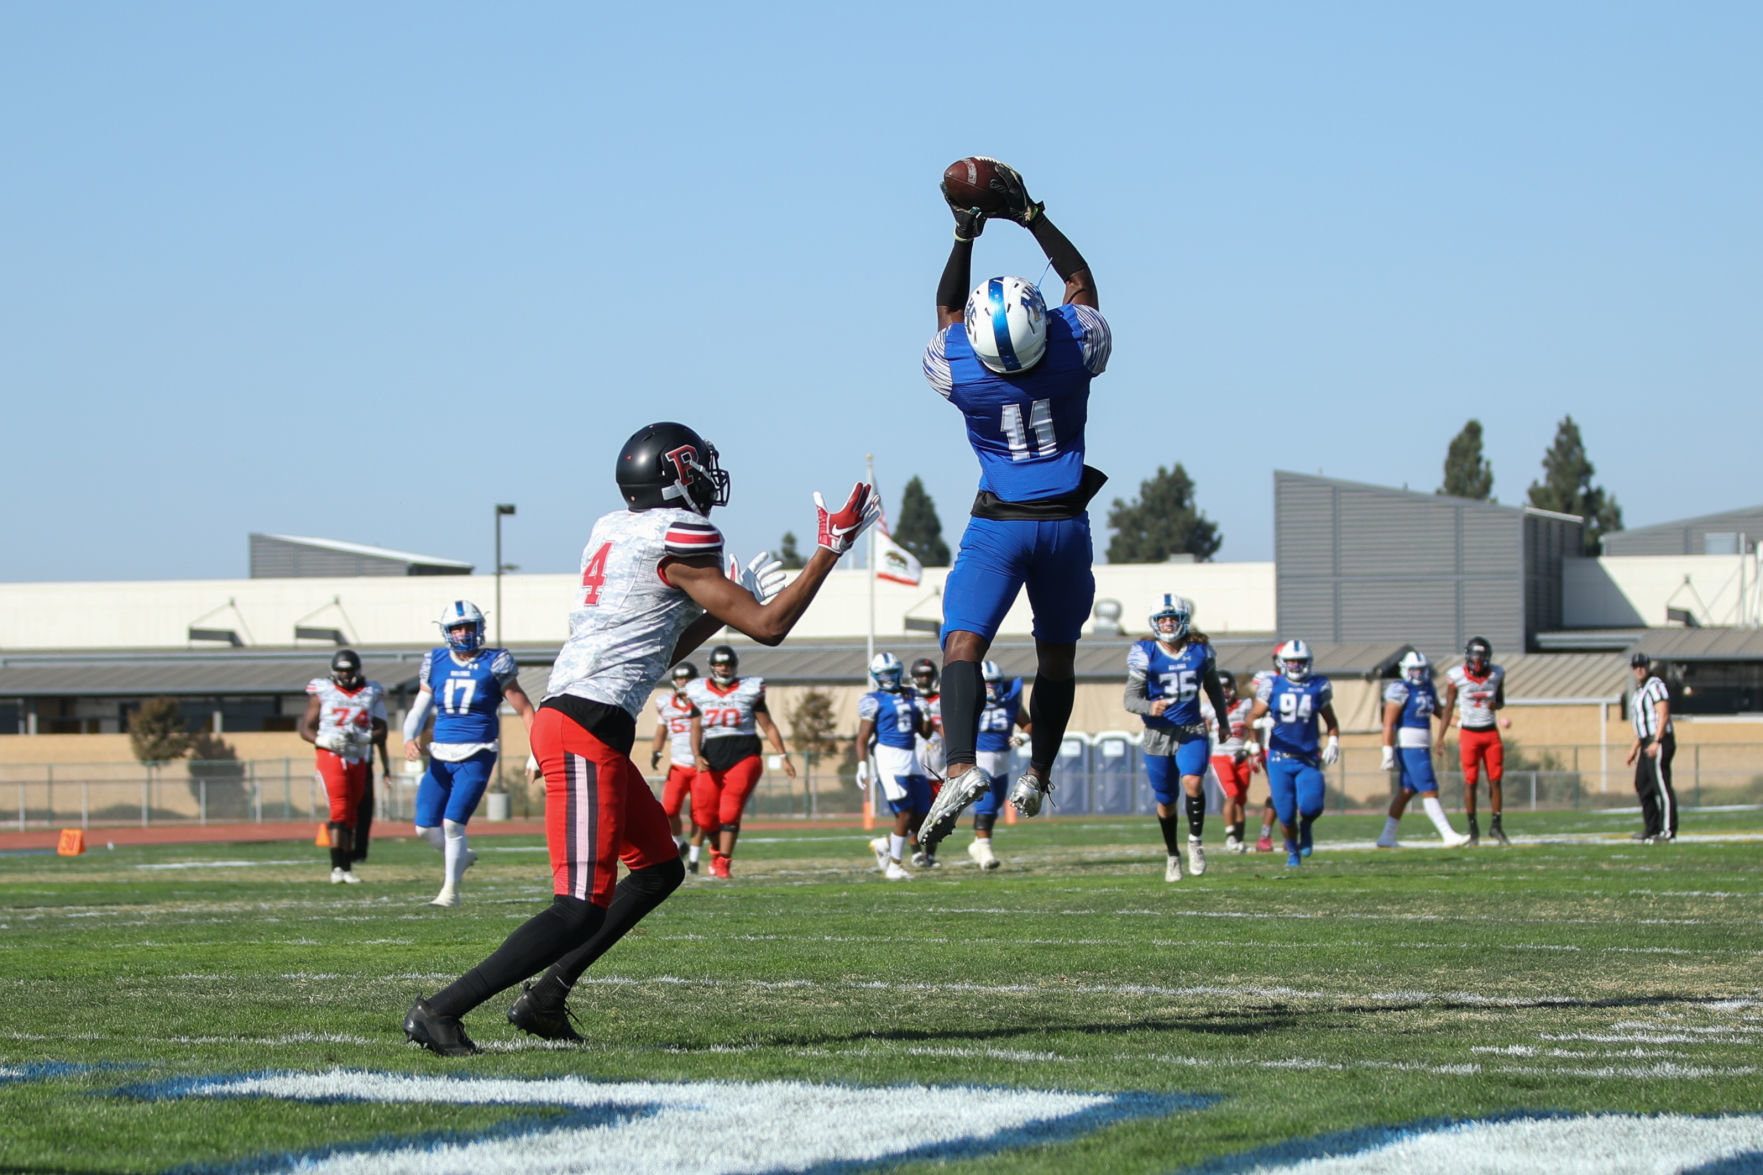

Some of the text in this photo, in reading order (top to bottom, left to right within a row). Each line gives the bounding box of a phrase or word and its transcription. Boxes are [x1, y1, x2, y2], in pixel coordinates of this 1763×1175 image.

[1000, 398, 1057, 462] 11
[582, 540, 615, 606] 4
[443, 678, 477, 715] 17
[1279, 693, 1312, 723] 94
[704, 708, 741, 729] 70
